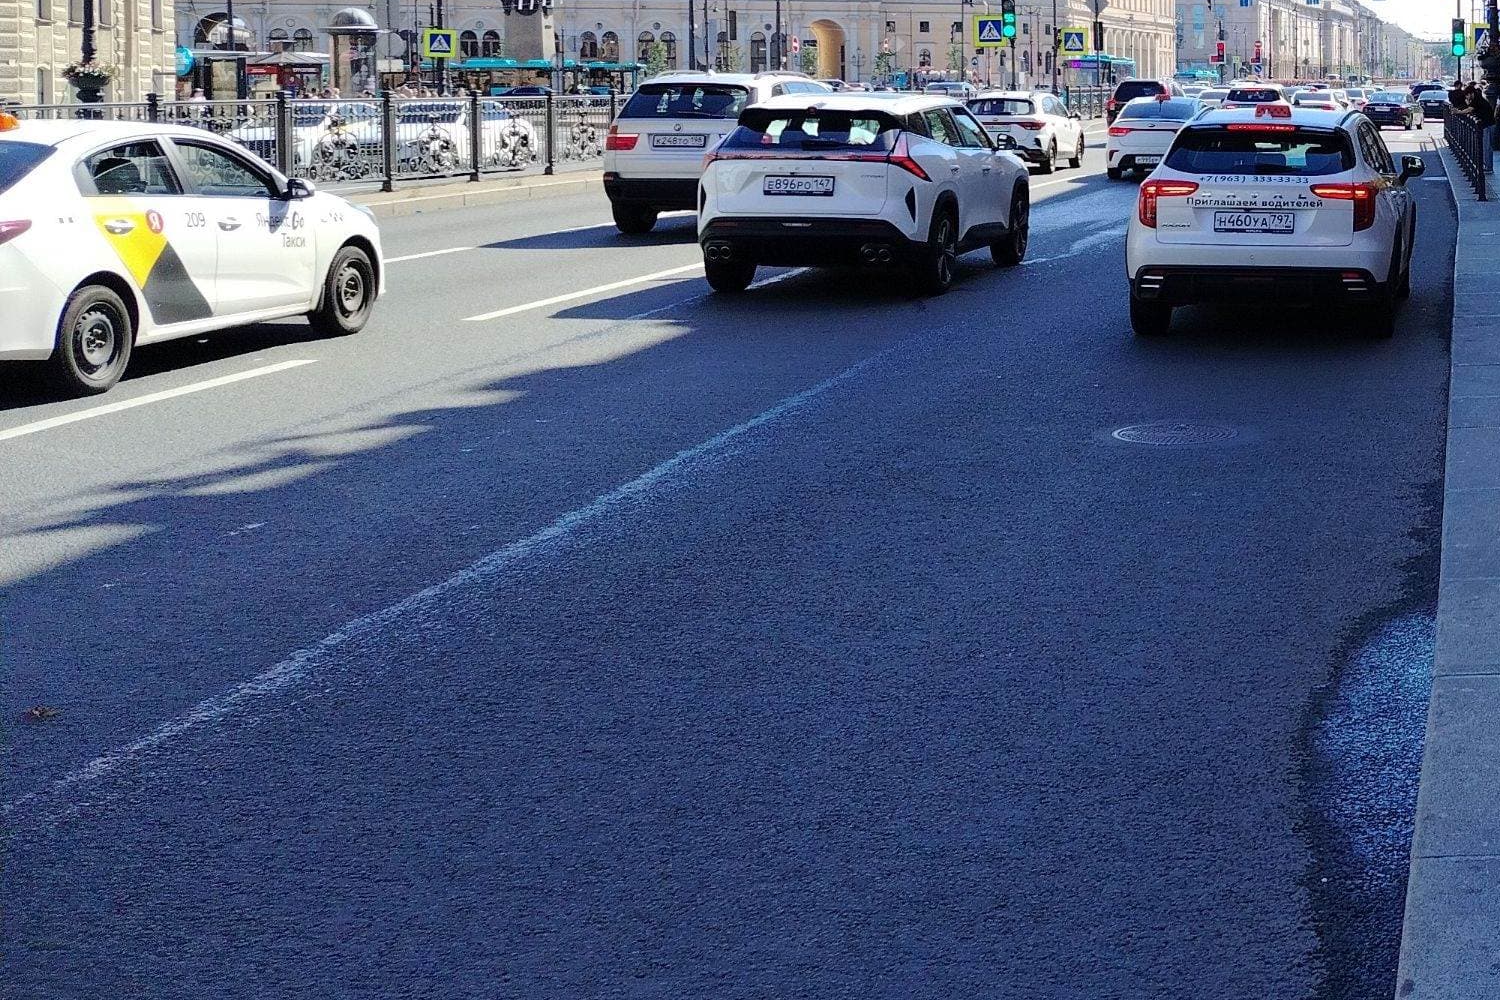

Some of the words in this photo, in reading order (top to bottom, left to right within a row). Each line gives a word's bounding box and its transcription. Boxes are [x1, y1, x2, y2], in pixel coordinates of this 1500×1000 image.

[1186, 197, 1257, 207] Приглашаем
[1261, 199, 1323, 208] водителей
[185, 212, 205, 228] 209
[1218, 214, 1268, 228] Н460УА
[1270, 214, 1290, 225] 797
[281, 232, 306, 248] Такси
